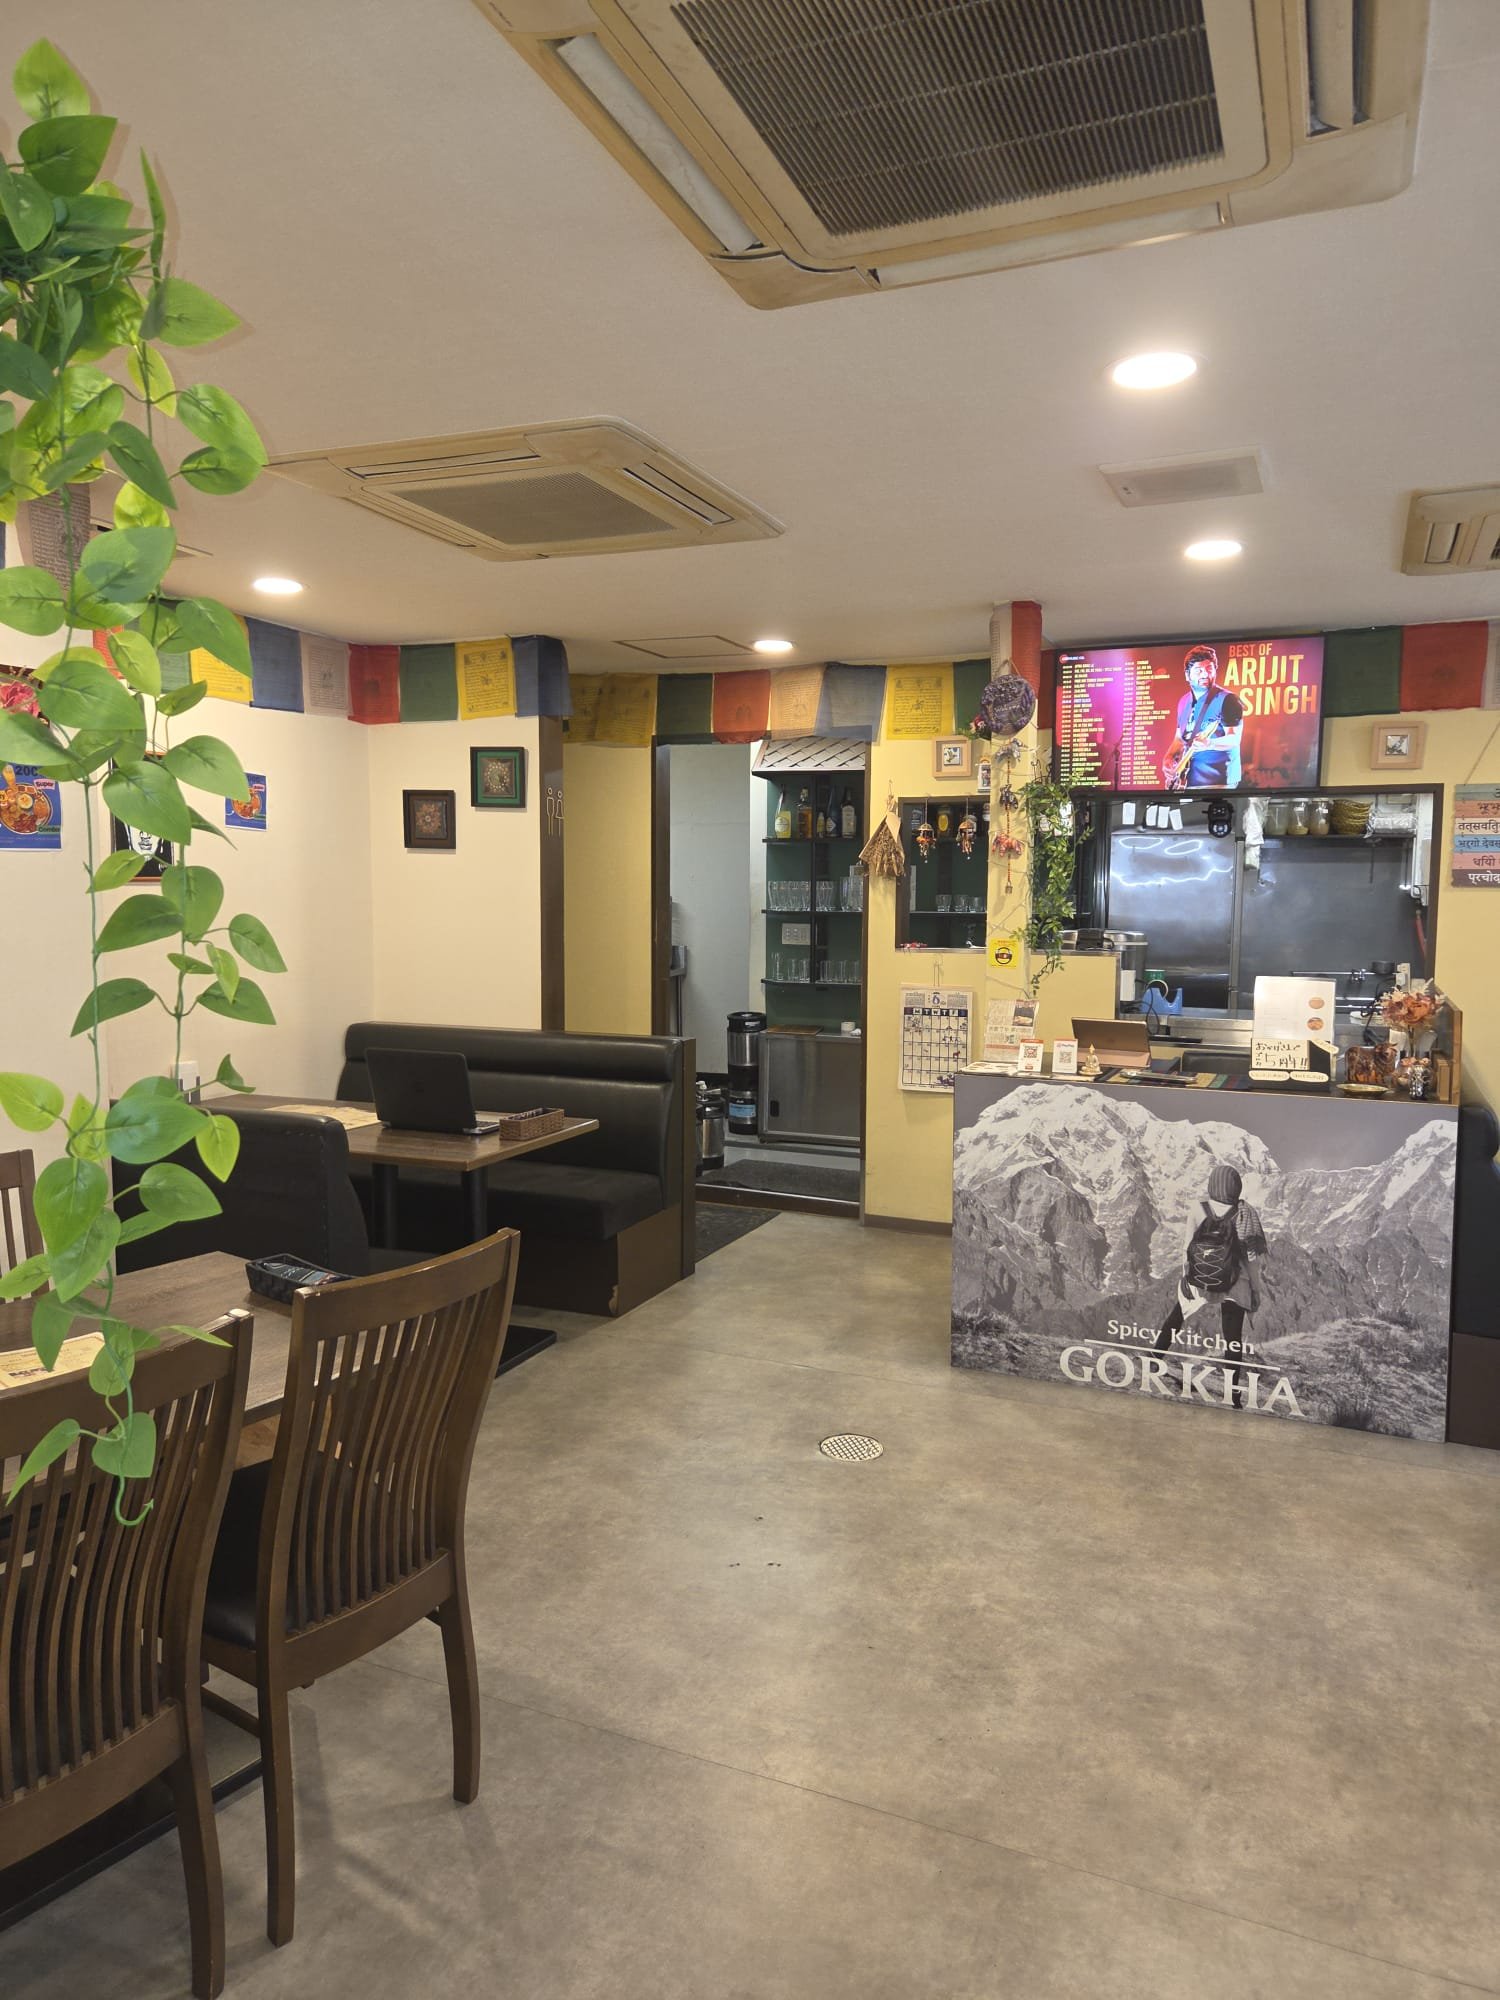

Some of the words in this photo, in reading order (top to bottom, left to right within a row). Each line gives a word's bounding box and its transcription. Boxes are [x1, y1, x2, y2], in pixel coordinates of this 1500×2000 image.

[1228, 644, 1256, 658] BEST
[1259, 643, 1273, 656] OF
[1223, 654, 1304, 687] ARIJIT
[1239, 685, 1318, 717] SINGH
[1107, 1319, 1162, 1345] Spicy
[1170, 1327, 1256, 1355] Kitchen
[1059, 1345, 1305, 1417] GORKHA
